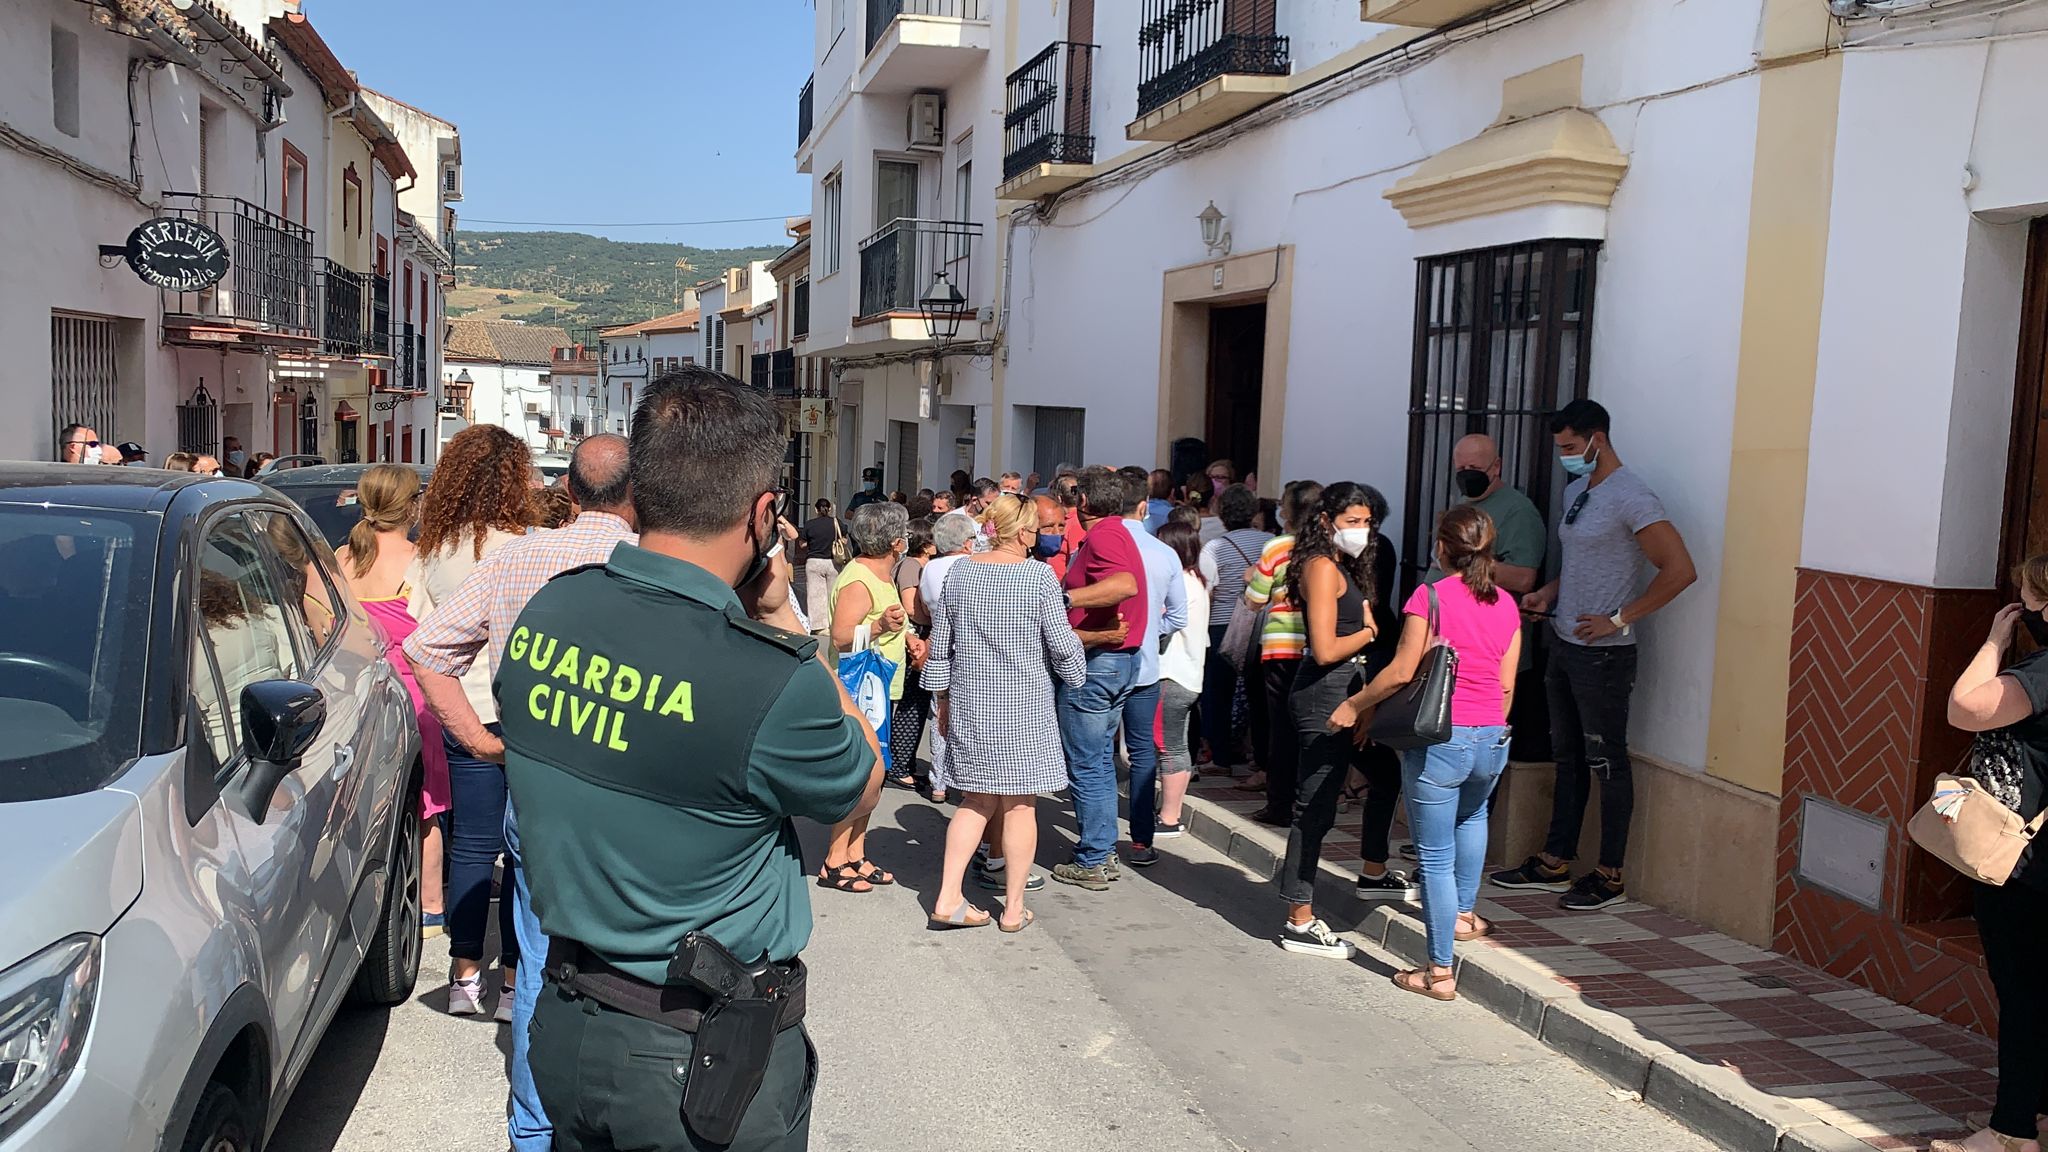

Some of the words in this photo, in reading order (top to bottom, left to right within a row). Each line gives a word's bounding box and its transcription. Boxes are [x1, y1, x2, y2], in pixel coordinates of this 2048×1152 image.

[134, 251, 179, 288] Carmen
[179, 267, 216, 288] Delia
[509, 626, 695, 723] GUARDIA
[528, 684, 629, 752] CIVIL
